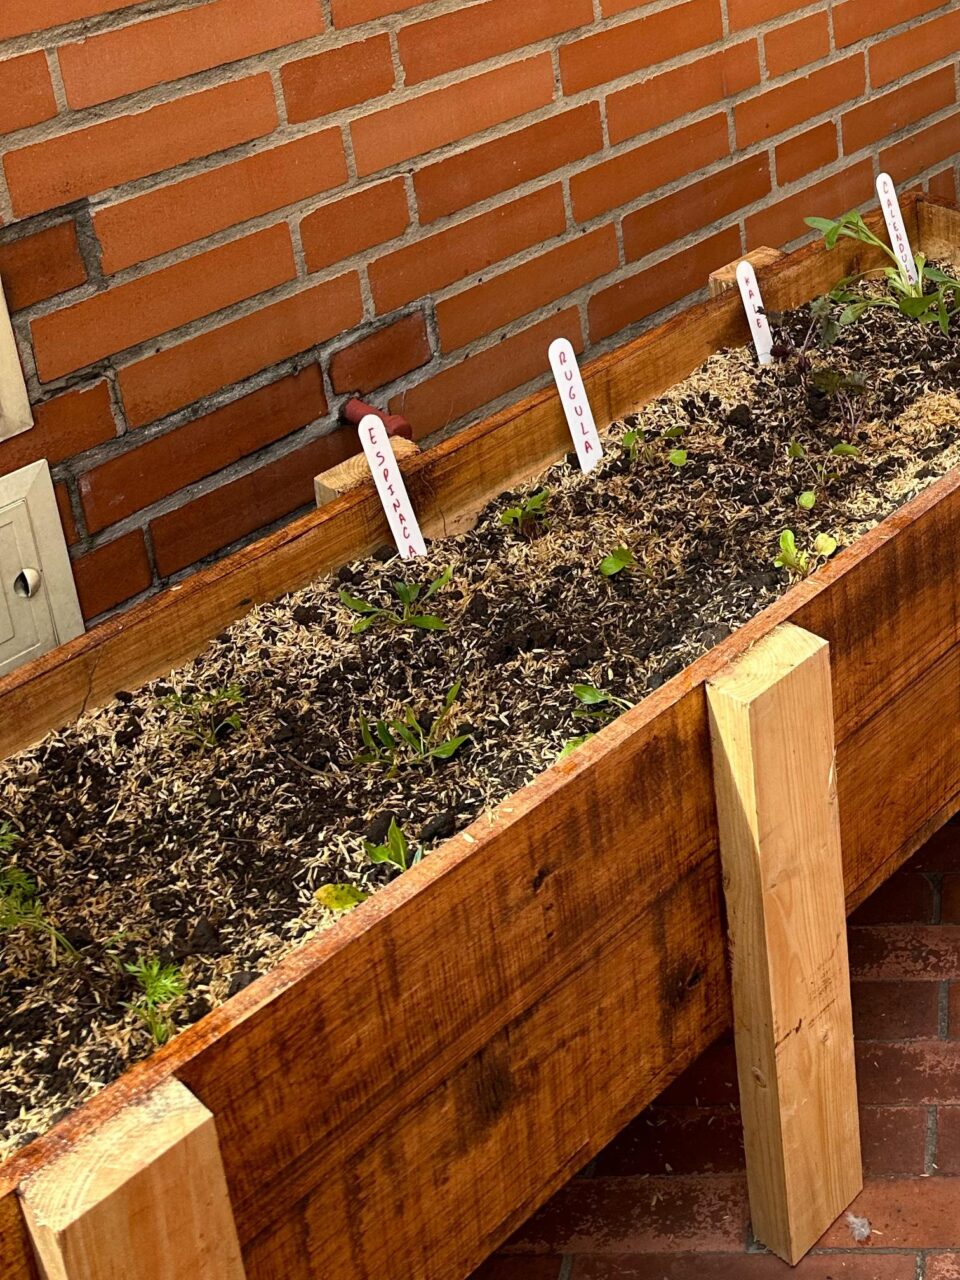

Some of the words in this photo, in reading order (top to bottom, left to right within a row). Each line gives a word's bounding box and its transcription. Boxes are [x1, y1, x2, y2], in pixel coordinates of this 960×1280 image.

[743, 276, 763, 329] KALE
[558, 351, 594, 454] RUGULA
[367, 427, 418, 558] ESPINACA
